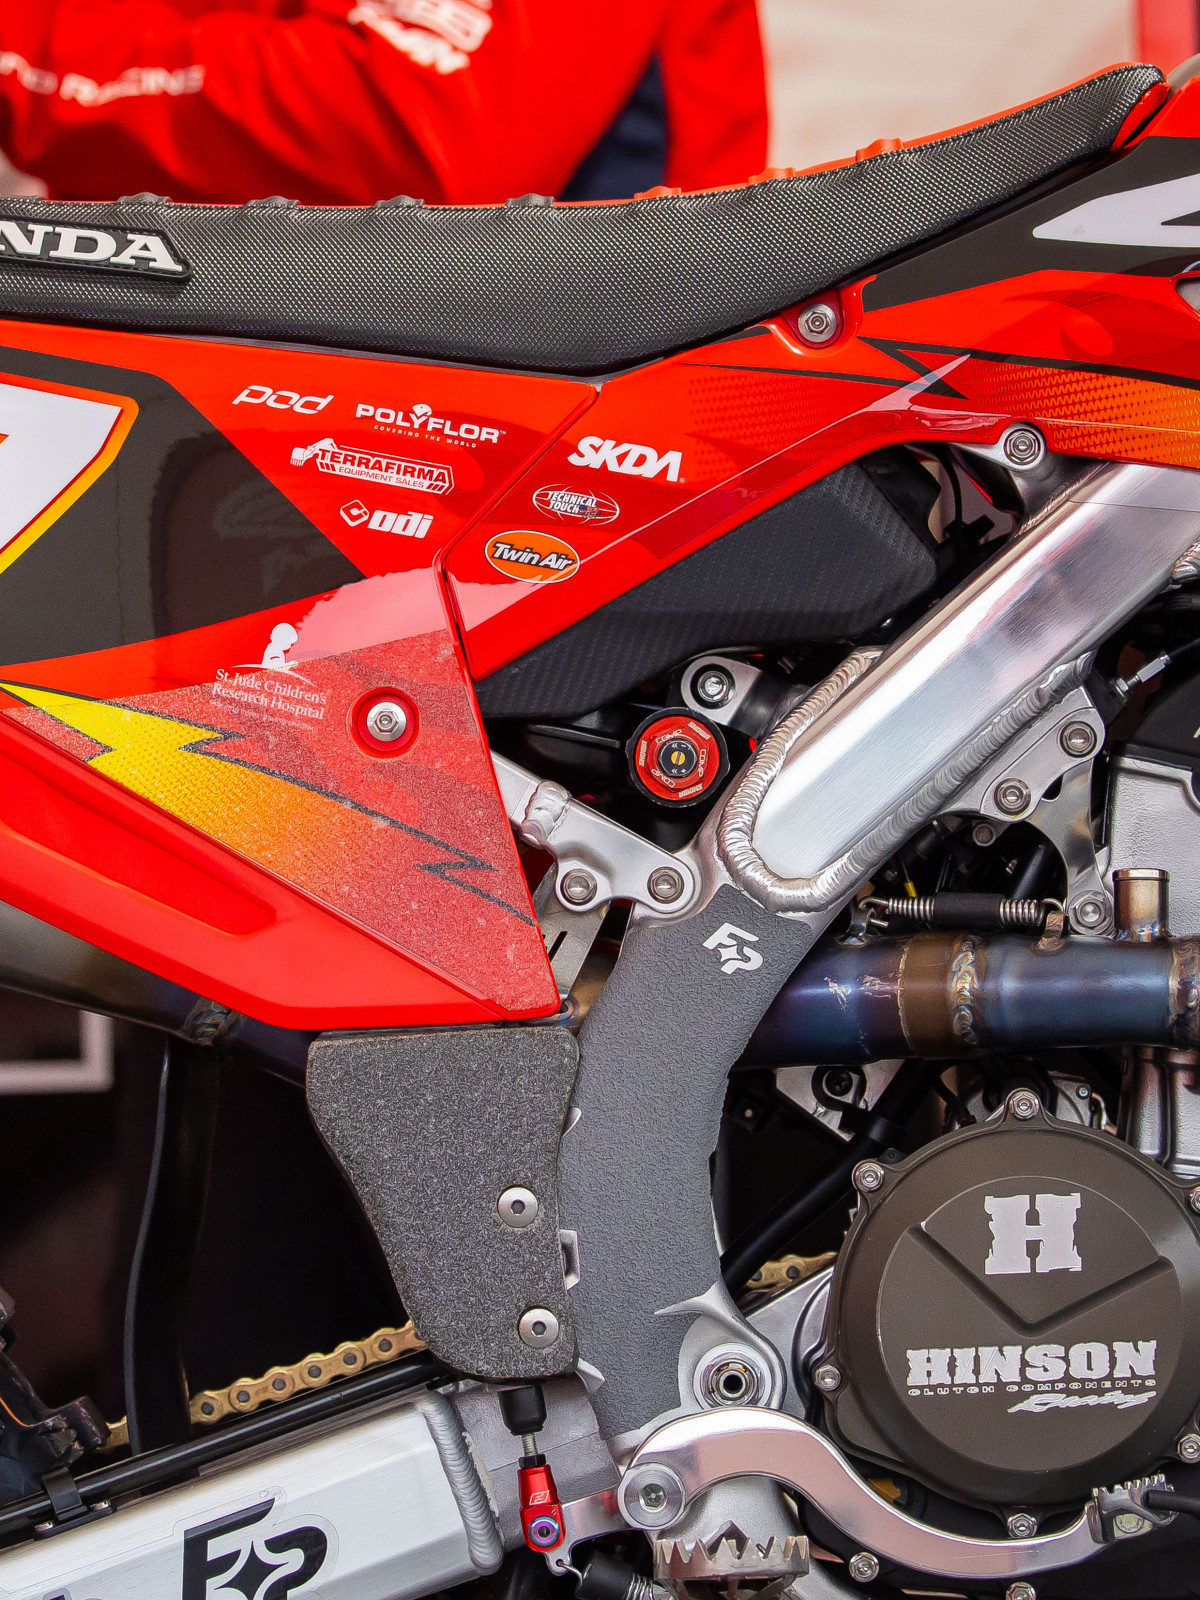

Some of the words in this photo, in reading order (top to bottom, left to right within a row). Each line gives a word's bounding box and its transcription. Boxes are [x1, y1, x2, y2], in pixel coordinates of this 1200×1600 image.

[232, 385, 335, 415] pod
[373, 424, 419, 438] COVERING
[425, 433, 441, 442] THE
[446, 438, 478, 448] WORLD
[317, 448, 448, 485] TERRAFIRMA
[567, 435, 683, 483] SKDA
[338, 466, 393, 483] EQUIPMENT
[395, 476, 425, 490] SALES
[547, 491, 598, 508] TECHNICAL
[548, 500, 580, 514] TOUCH
[493, 542, 539, 565] Twin
[539, 553, 574, 571] Air
[211, 682, 269, 707] Research
[270, 696, 325, 720] Hospital
[264, 680, 327, 704] Children's
[697, 748, 707, 777] COMP
[651, 768, 676, 788] COMP
[984, 1192, 1082, 1275] H
[906, 1340, 1157, 1386] HINSON
[908, 1385, 995, 1396] CLUTCH
[1006, 1378, 1157, 1393] COMPONENTS
